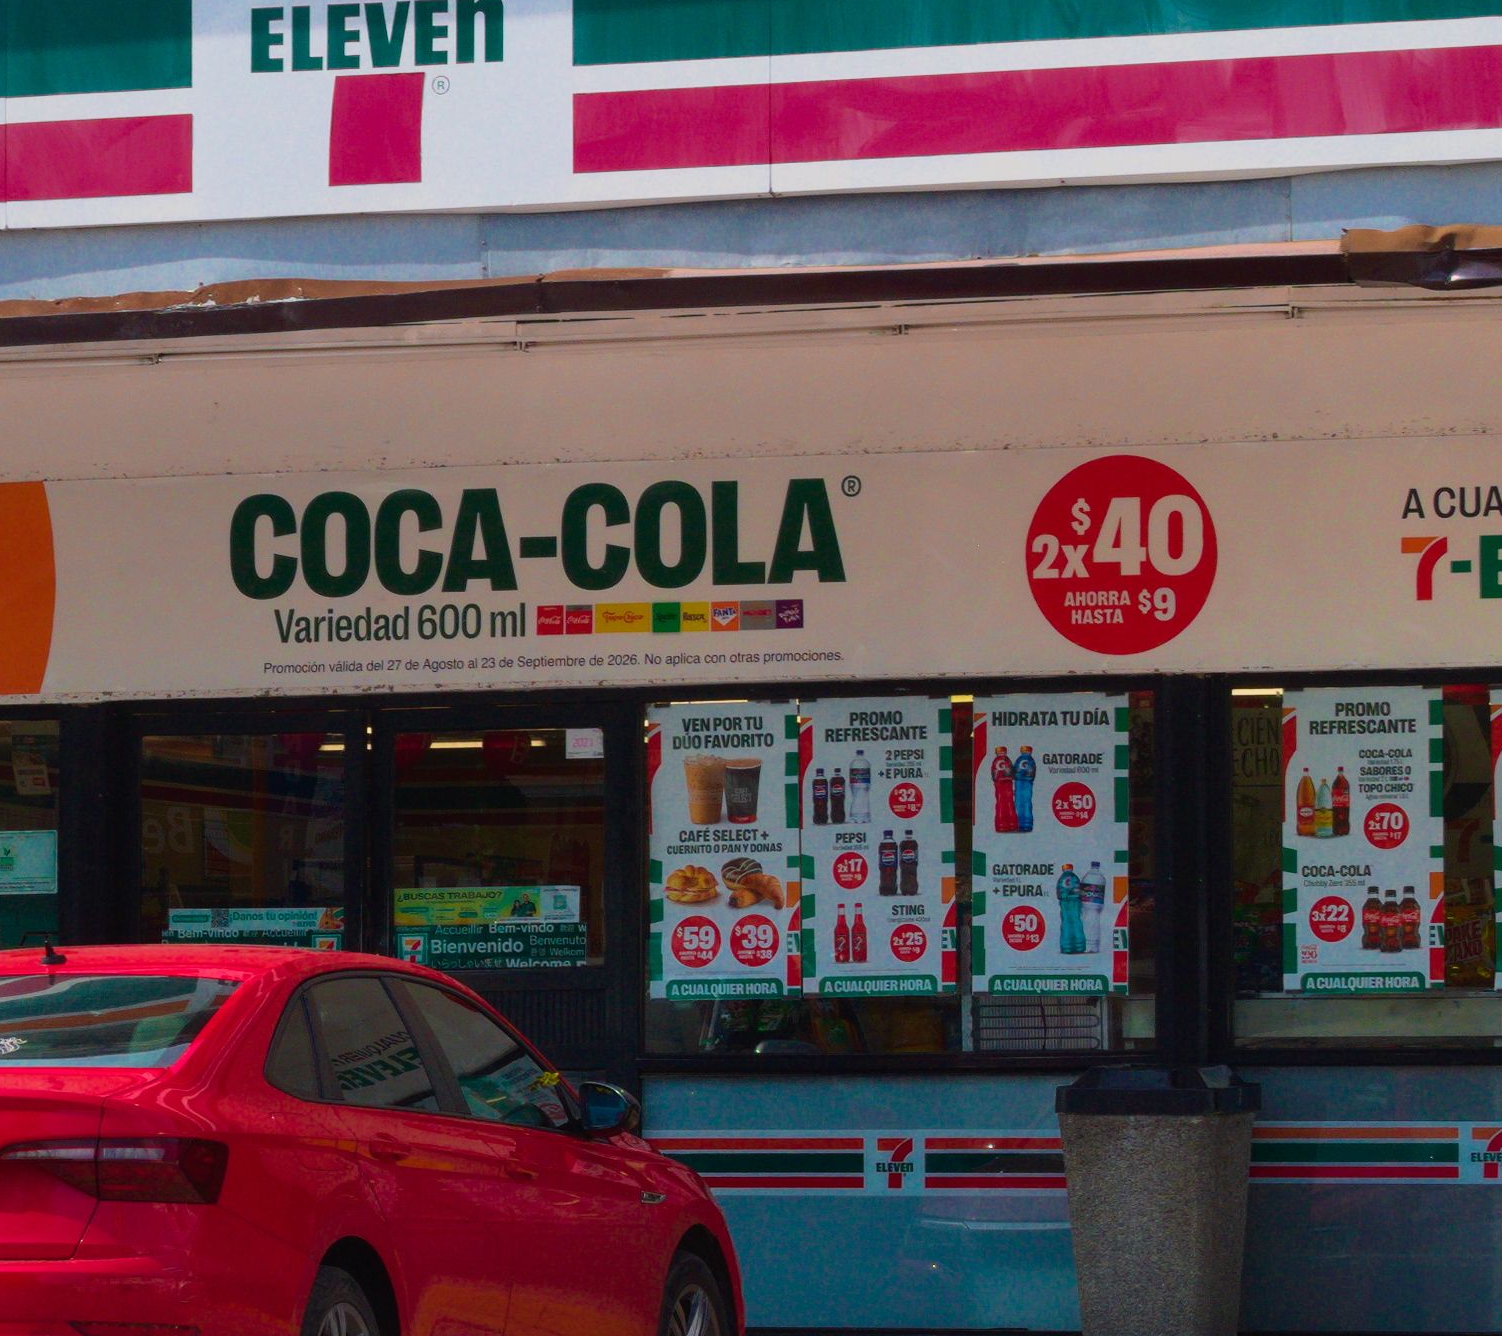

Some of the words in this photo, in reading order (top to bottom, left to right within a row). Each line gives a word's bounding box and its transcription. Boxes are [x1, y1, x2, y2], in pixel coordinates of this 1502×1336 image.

[1401, 488, 1426, 520] A
[229, 477, 847, 600] COCA-COLA
[1031, 537, 1090, 581] 2x
[1070, 493, 1204, 578] $40
[1063, 589, 1132, 610] AHORRA
[1070, 607, 1124, 626] HASTA
[1137, 586, 1177, 623] $9
[273, 604, 411, 644] Variedad
[417, 602, 484, 640] 600
[489, 602, 527, 639] ml
[263, 662, 325, 674] Promoción
[329, 660, 363, 673] válida
[366, 660, 384, 672] del
[386, 660, 402, 671] 27
[405, 659, 420, 671] de
[422, 657, 464, 673] Agosto
[467, 657, 478, 669] al
[481, 657, 496, 669] 23
[499, 656, 514, 668] de
[517, 654, 586, 670] Septiembre
[589, 655, 604, 666] de
[607, 654, 640, 666] 2026.
[644, 653, 662, 665] No
[665, 652, 701, 667] aplica
[704, 653, 726, 664] con
[729, 652, 760, 663] otras
[763, 650, 844, 664] promociones.
[991, 711, 1060, 726] HIDRATA
[1061, 711, 1080, 725] TU
[1083, 707, 1110, 725] DÍA
[1335, 701, 1391, 717] PROMO
[681, 718, 710, 733] VEN
[713, 717, 742, 731] POR
[744, 716, 763, 731] TU
[849, 710, 903, 726] PROMO
[825, 726, 928, 743] REFRESCANTE
[1309, 719, 1417, 735] REFRESCANTE
[672, 732, 701, 750] DÚO
[704, 733, 775, 749] FAVORITO
[893, 749, 925, 760] PEPSI
[1042, 753, 1104, 765] GATORADE
[1358, 748, 1413, 759] COCA-COLA
[1359, 766, 1403, 776] SABORES
[1358, 783, 1383, 793] TOPO
[1384, 783, 1414, 792] CHICO
[679, 827, 710, 843] CAFÉ
[712, 829, 758, 842] SELECT
[835, 832, 867, 843] PEPSI
[666, 844, 712, 854] CUERNITO
[714, 844, 720, 853] O
[721, 843, 742, 853] PAN
[742, 843, 749, 852] Y
[750, 843, 782, 853] DONAS
[992, 863, 1055, 876] GATORADE
[1301, 864, 1372, 878] COCA-COLA
[396, 892, 446, 903] ¿BUSCAS
[447, 891, 503, 900] TRABAJO?
[1002, 884, 1044, 897] EPURA
[266, 912, 278, 921] tu
[278, 911, 317, 923] opinión!
[891, 904, 925, 916] STING
[1322, 904, 1349, 922] $22
[488, 922, 555, 934] Bem-vindo
[1009, 914, 1038, 932] $50
[529, 935, 587, 946] Benvenuto
[677, 925, 716, 950] $59
[735, 924, 774, 949] $39
[430, 939, 524, 955] Bienvenido
[671, 984, 680, 996] A
[681, 983, 745, 997] CUALQUIER
[746, 982, 777, 995] HORA
[993, 979, 1002, 991] A
[1003, 978, 1069, 993] CUALQUIER
[1070, 978, 1103, 990] HORA
